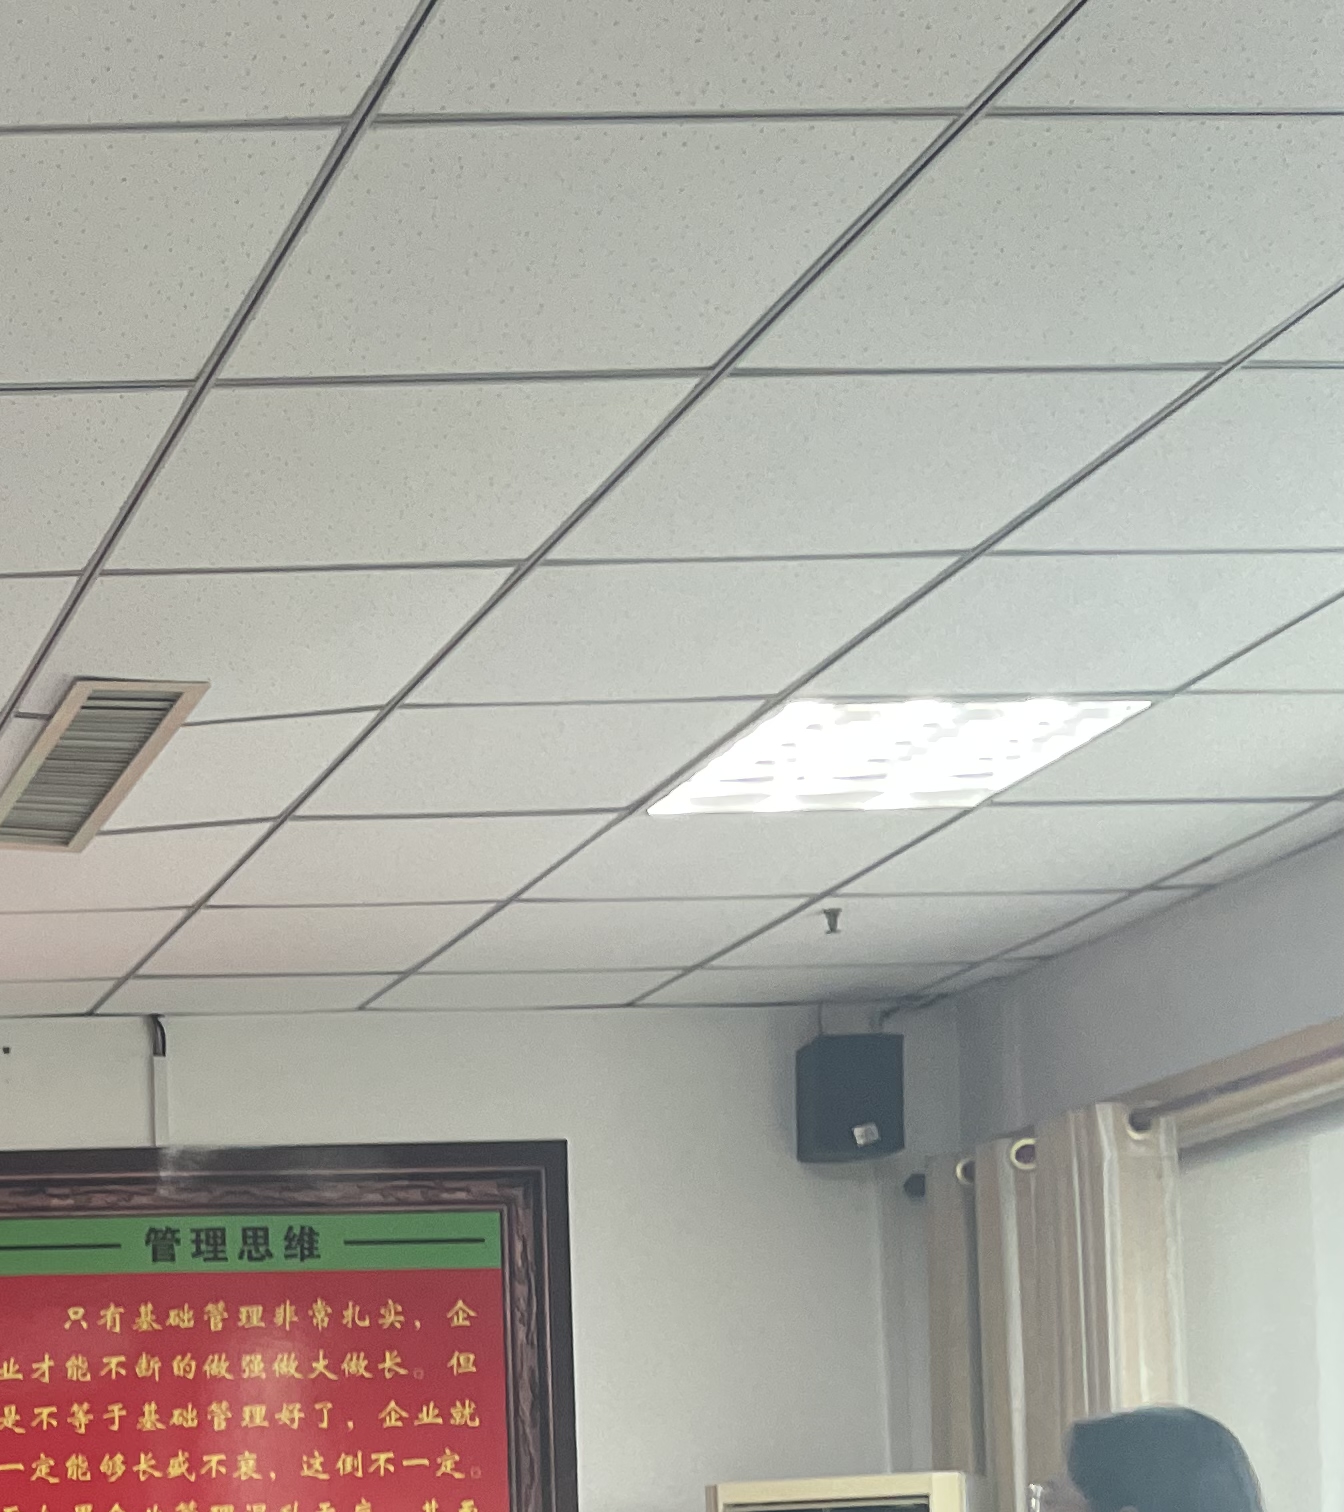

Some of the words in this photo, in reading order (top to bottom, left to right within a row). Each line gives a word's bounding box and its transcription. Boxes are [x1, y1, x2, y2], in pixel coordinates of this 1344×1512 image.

[144, 1225, 322, 1264] 管理思维
[64, 1299, 478, 1334] 只有基础管理非常扎实，企
